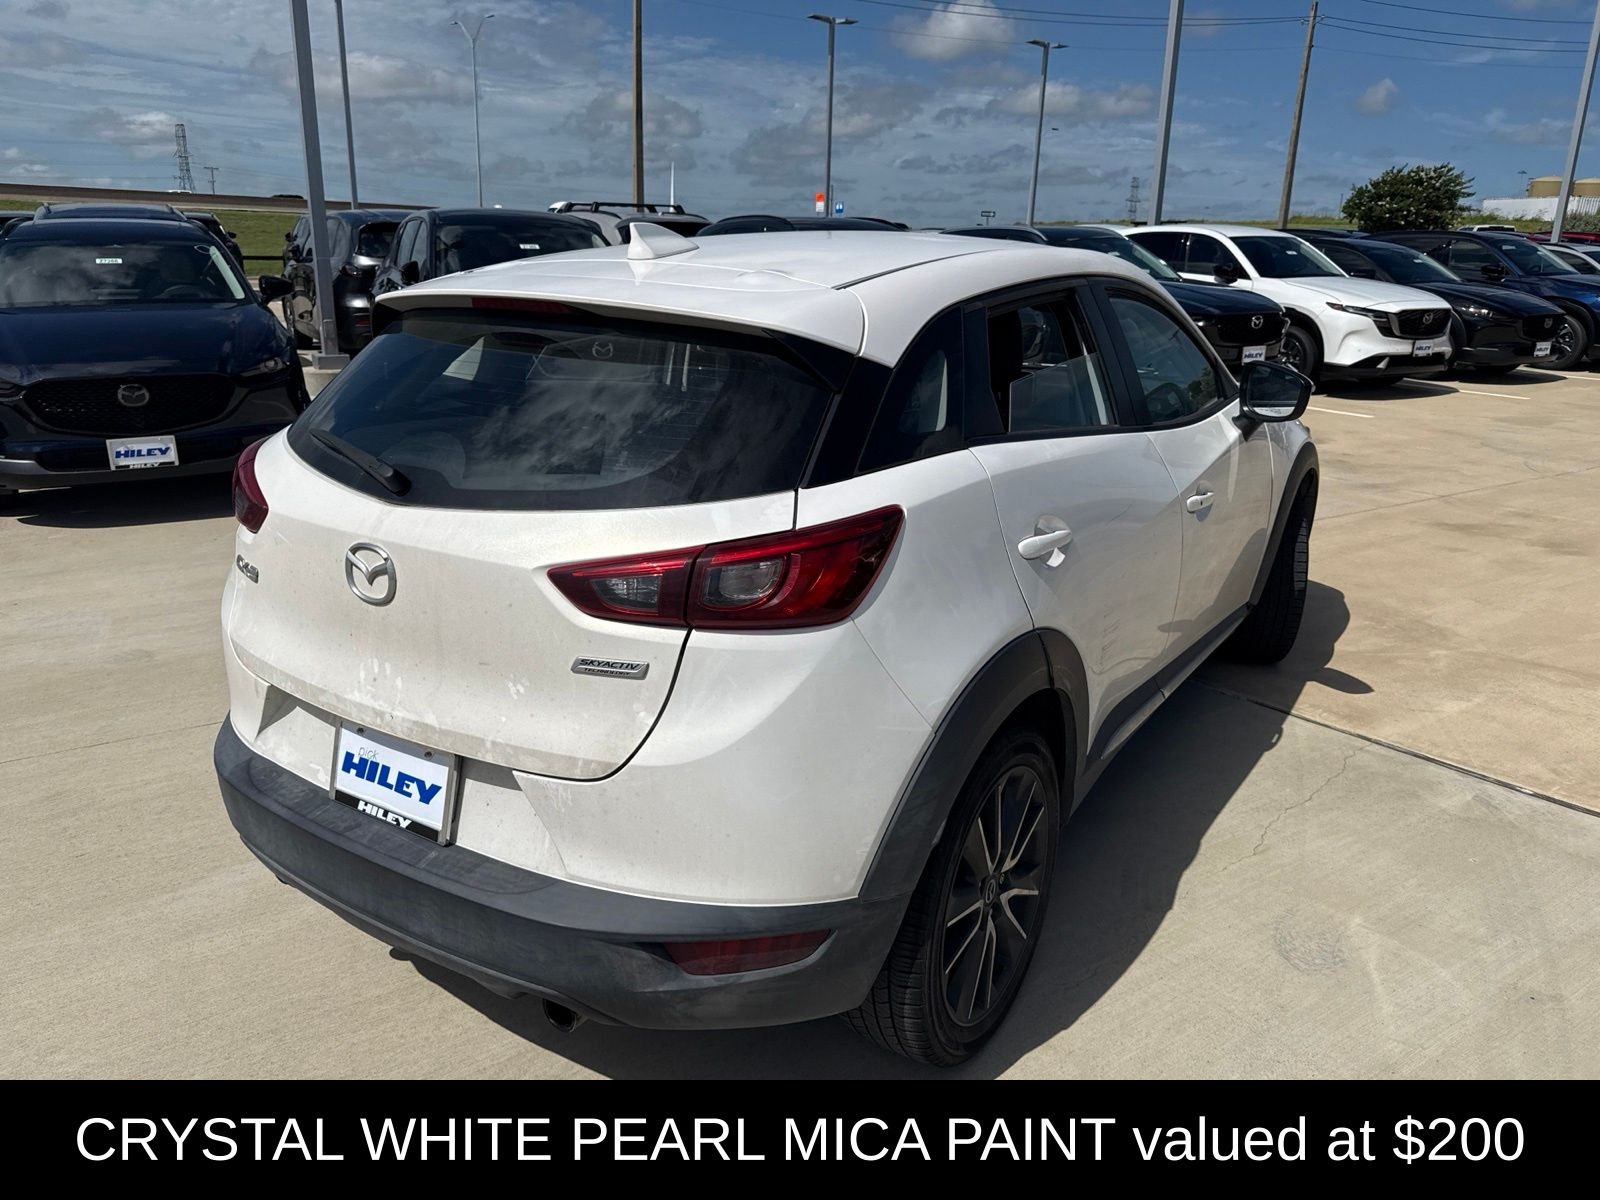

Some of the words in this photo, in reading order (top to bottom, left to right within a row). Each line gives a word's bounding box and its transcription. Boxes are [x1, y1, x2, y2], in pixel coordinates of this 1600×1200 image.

[115, 446, 170, 459] HILEY
[579, 658, 641, 671] SKYACTIV
[341, 750, 443, 805] HILEY
[357, 800, 412, 829] HILEY
